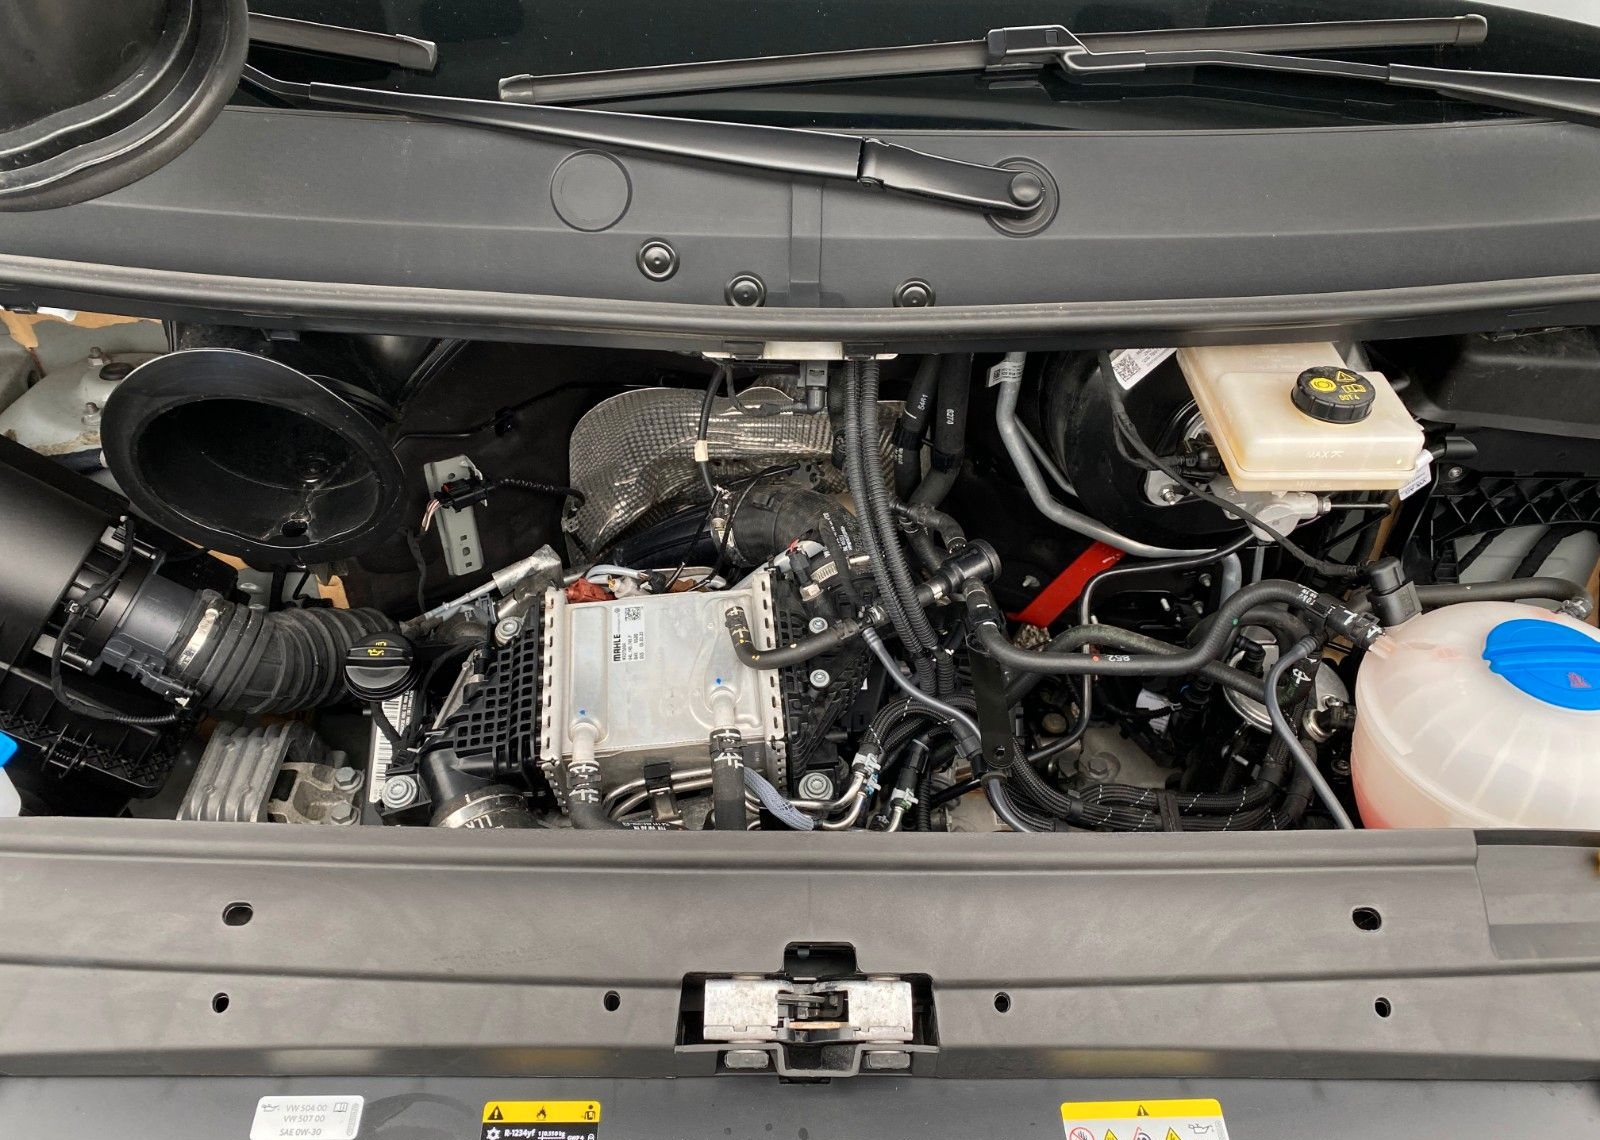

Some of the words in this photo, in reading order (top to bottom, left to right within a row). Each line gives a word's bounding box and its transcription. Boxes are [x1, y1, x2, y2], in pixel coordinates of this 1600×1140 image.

[613, 634, 621, 662] MAHLE
[286, 1104, 300, 1112] VW
[301, 1104, 315, 1112] 504
[317, 1104, 328, 1112] 00
[283, 1114, 298, 1122] VW
[298, 1114, 314, 1122] 507
[315, 1114, 326, 1122] 00
[279, 1128, 294, 1136] SAE
[295, 1128, 322, 1136] 0W-30
[504, 1128, 536, 1139] R-1234yf
